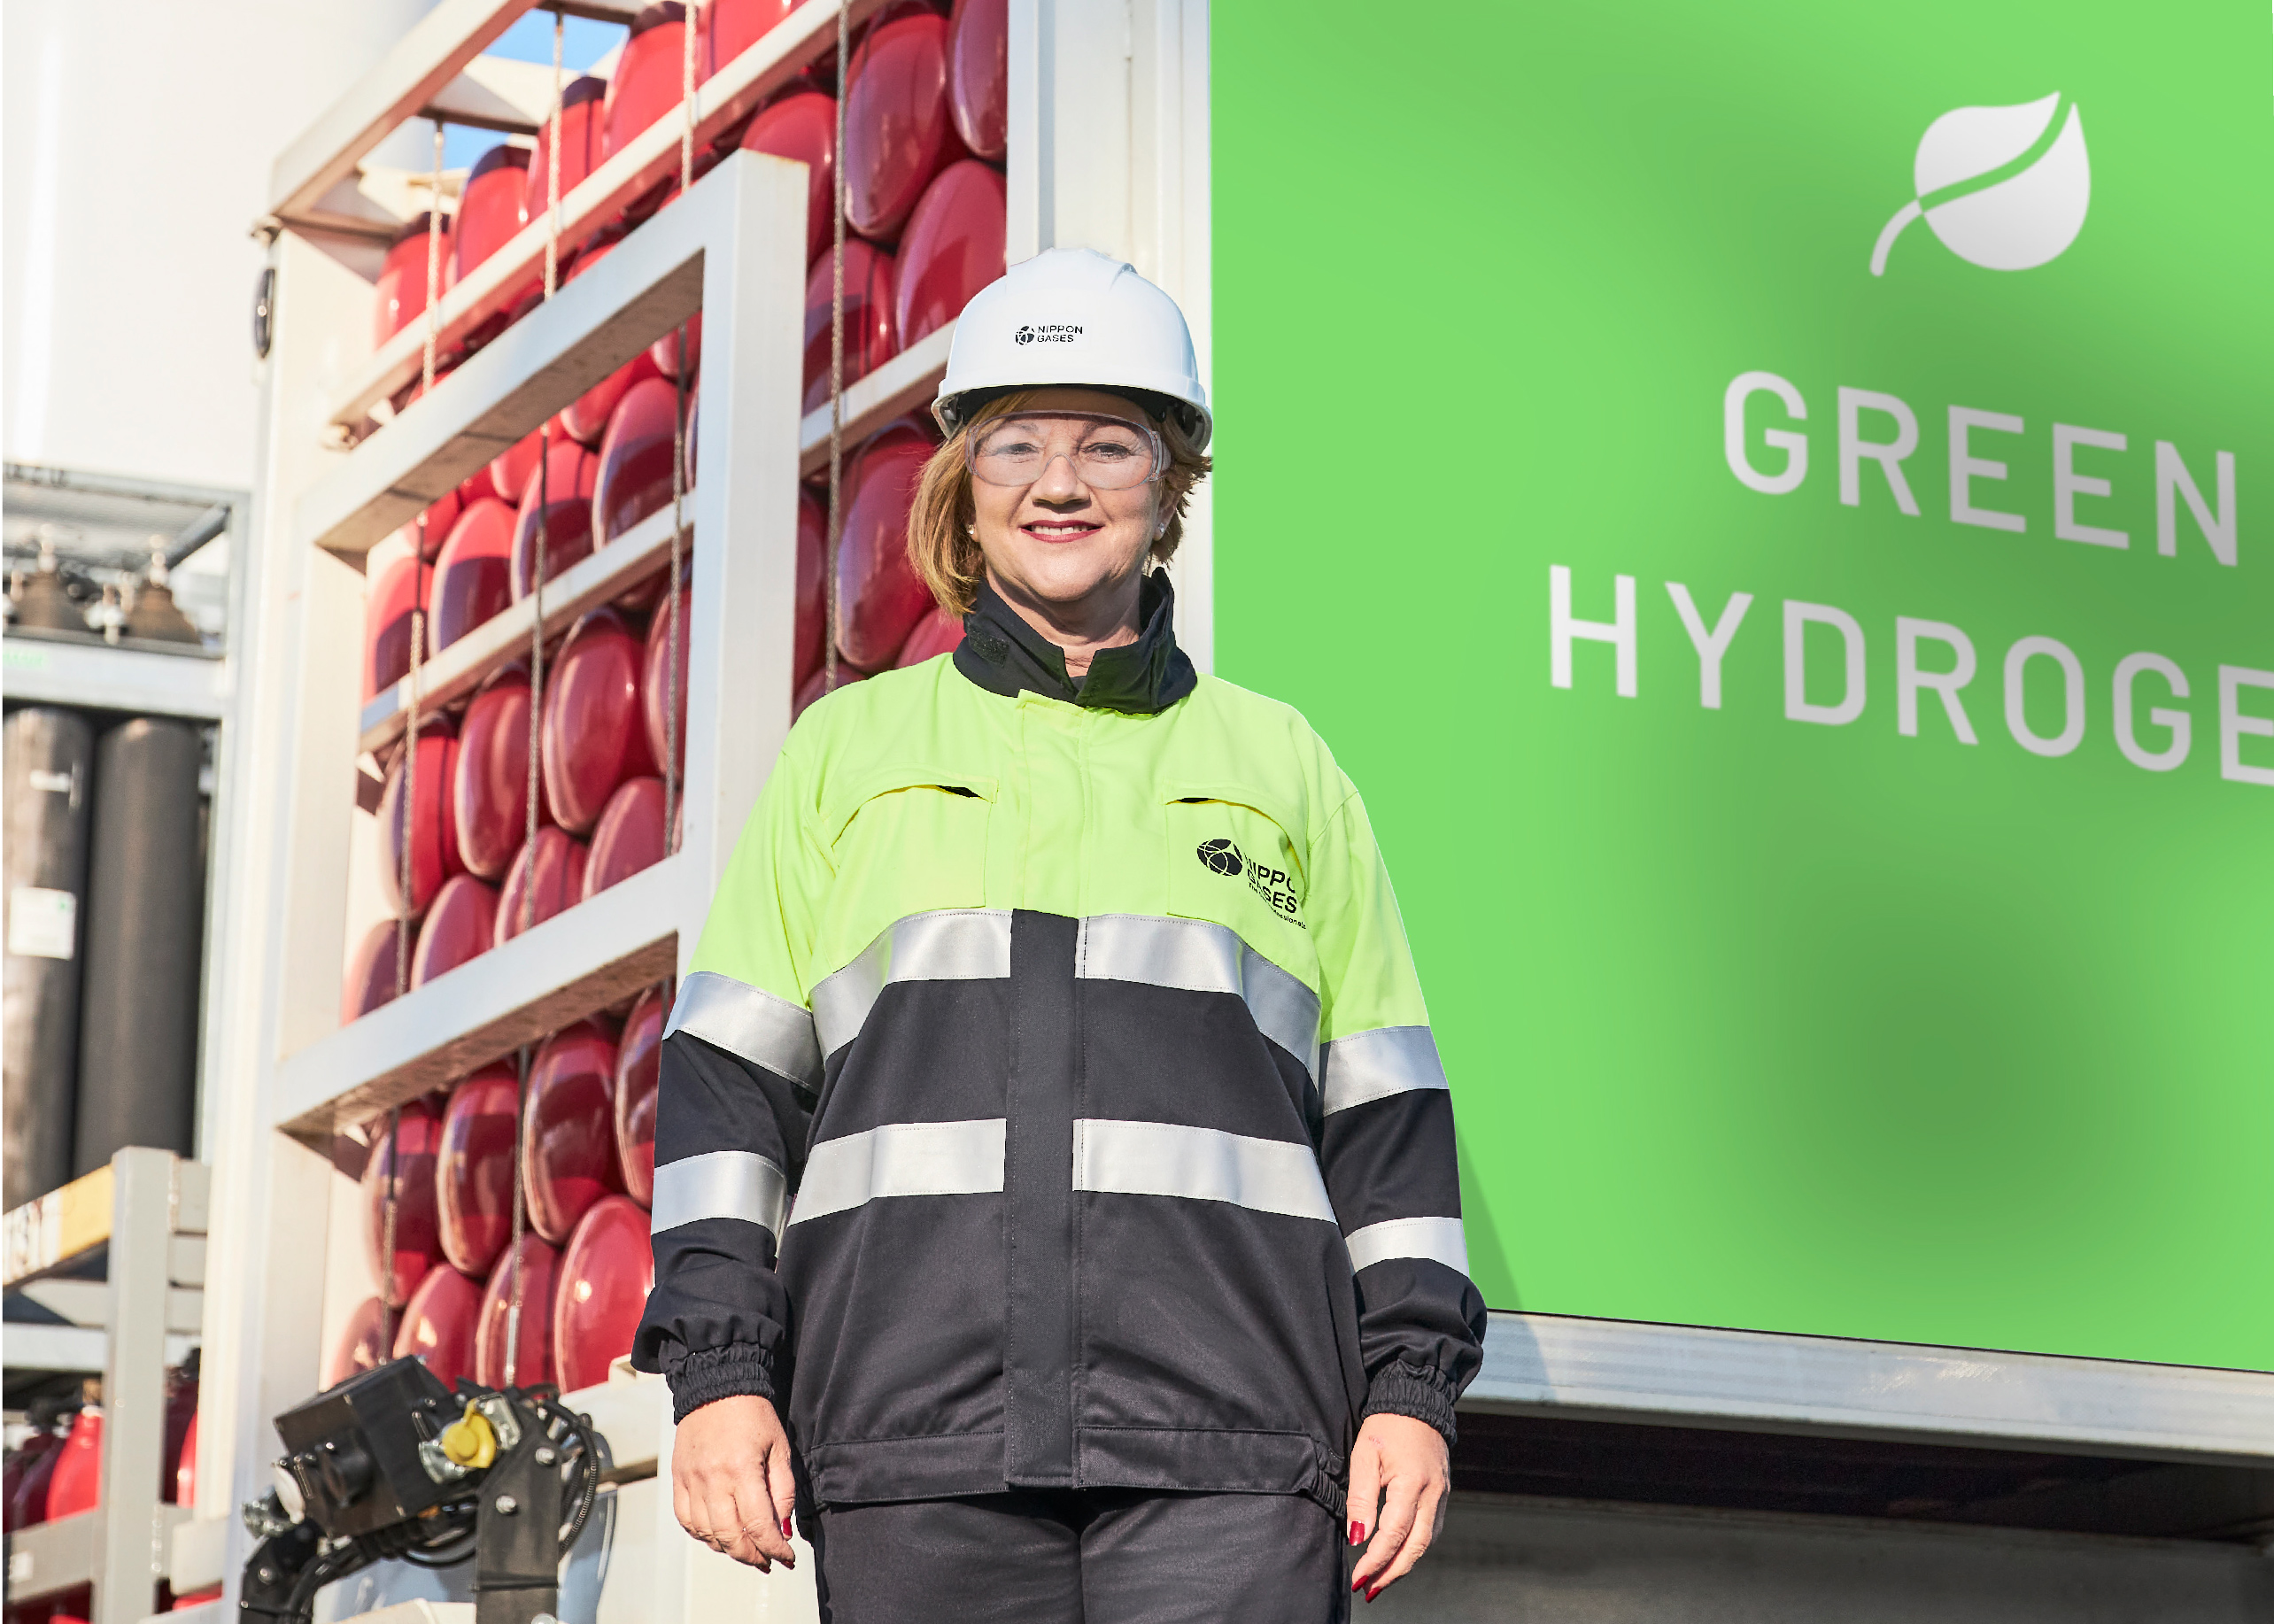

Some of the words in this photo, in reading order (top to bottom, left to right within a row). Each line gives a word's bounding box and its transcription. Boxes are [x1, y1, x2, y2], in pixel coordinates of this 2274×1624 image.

[1037, 324, 1084, 335] NIPPON
[1037, 334, 1075, 343] GASES
[1723, 369, 2239, 568] GREEN
[1549, 563, 2274, 787] HYDROGE
[1243, 852, 1296, 894] NIPP
